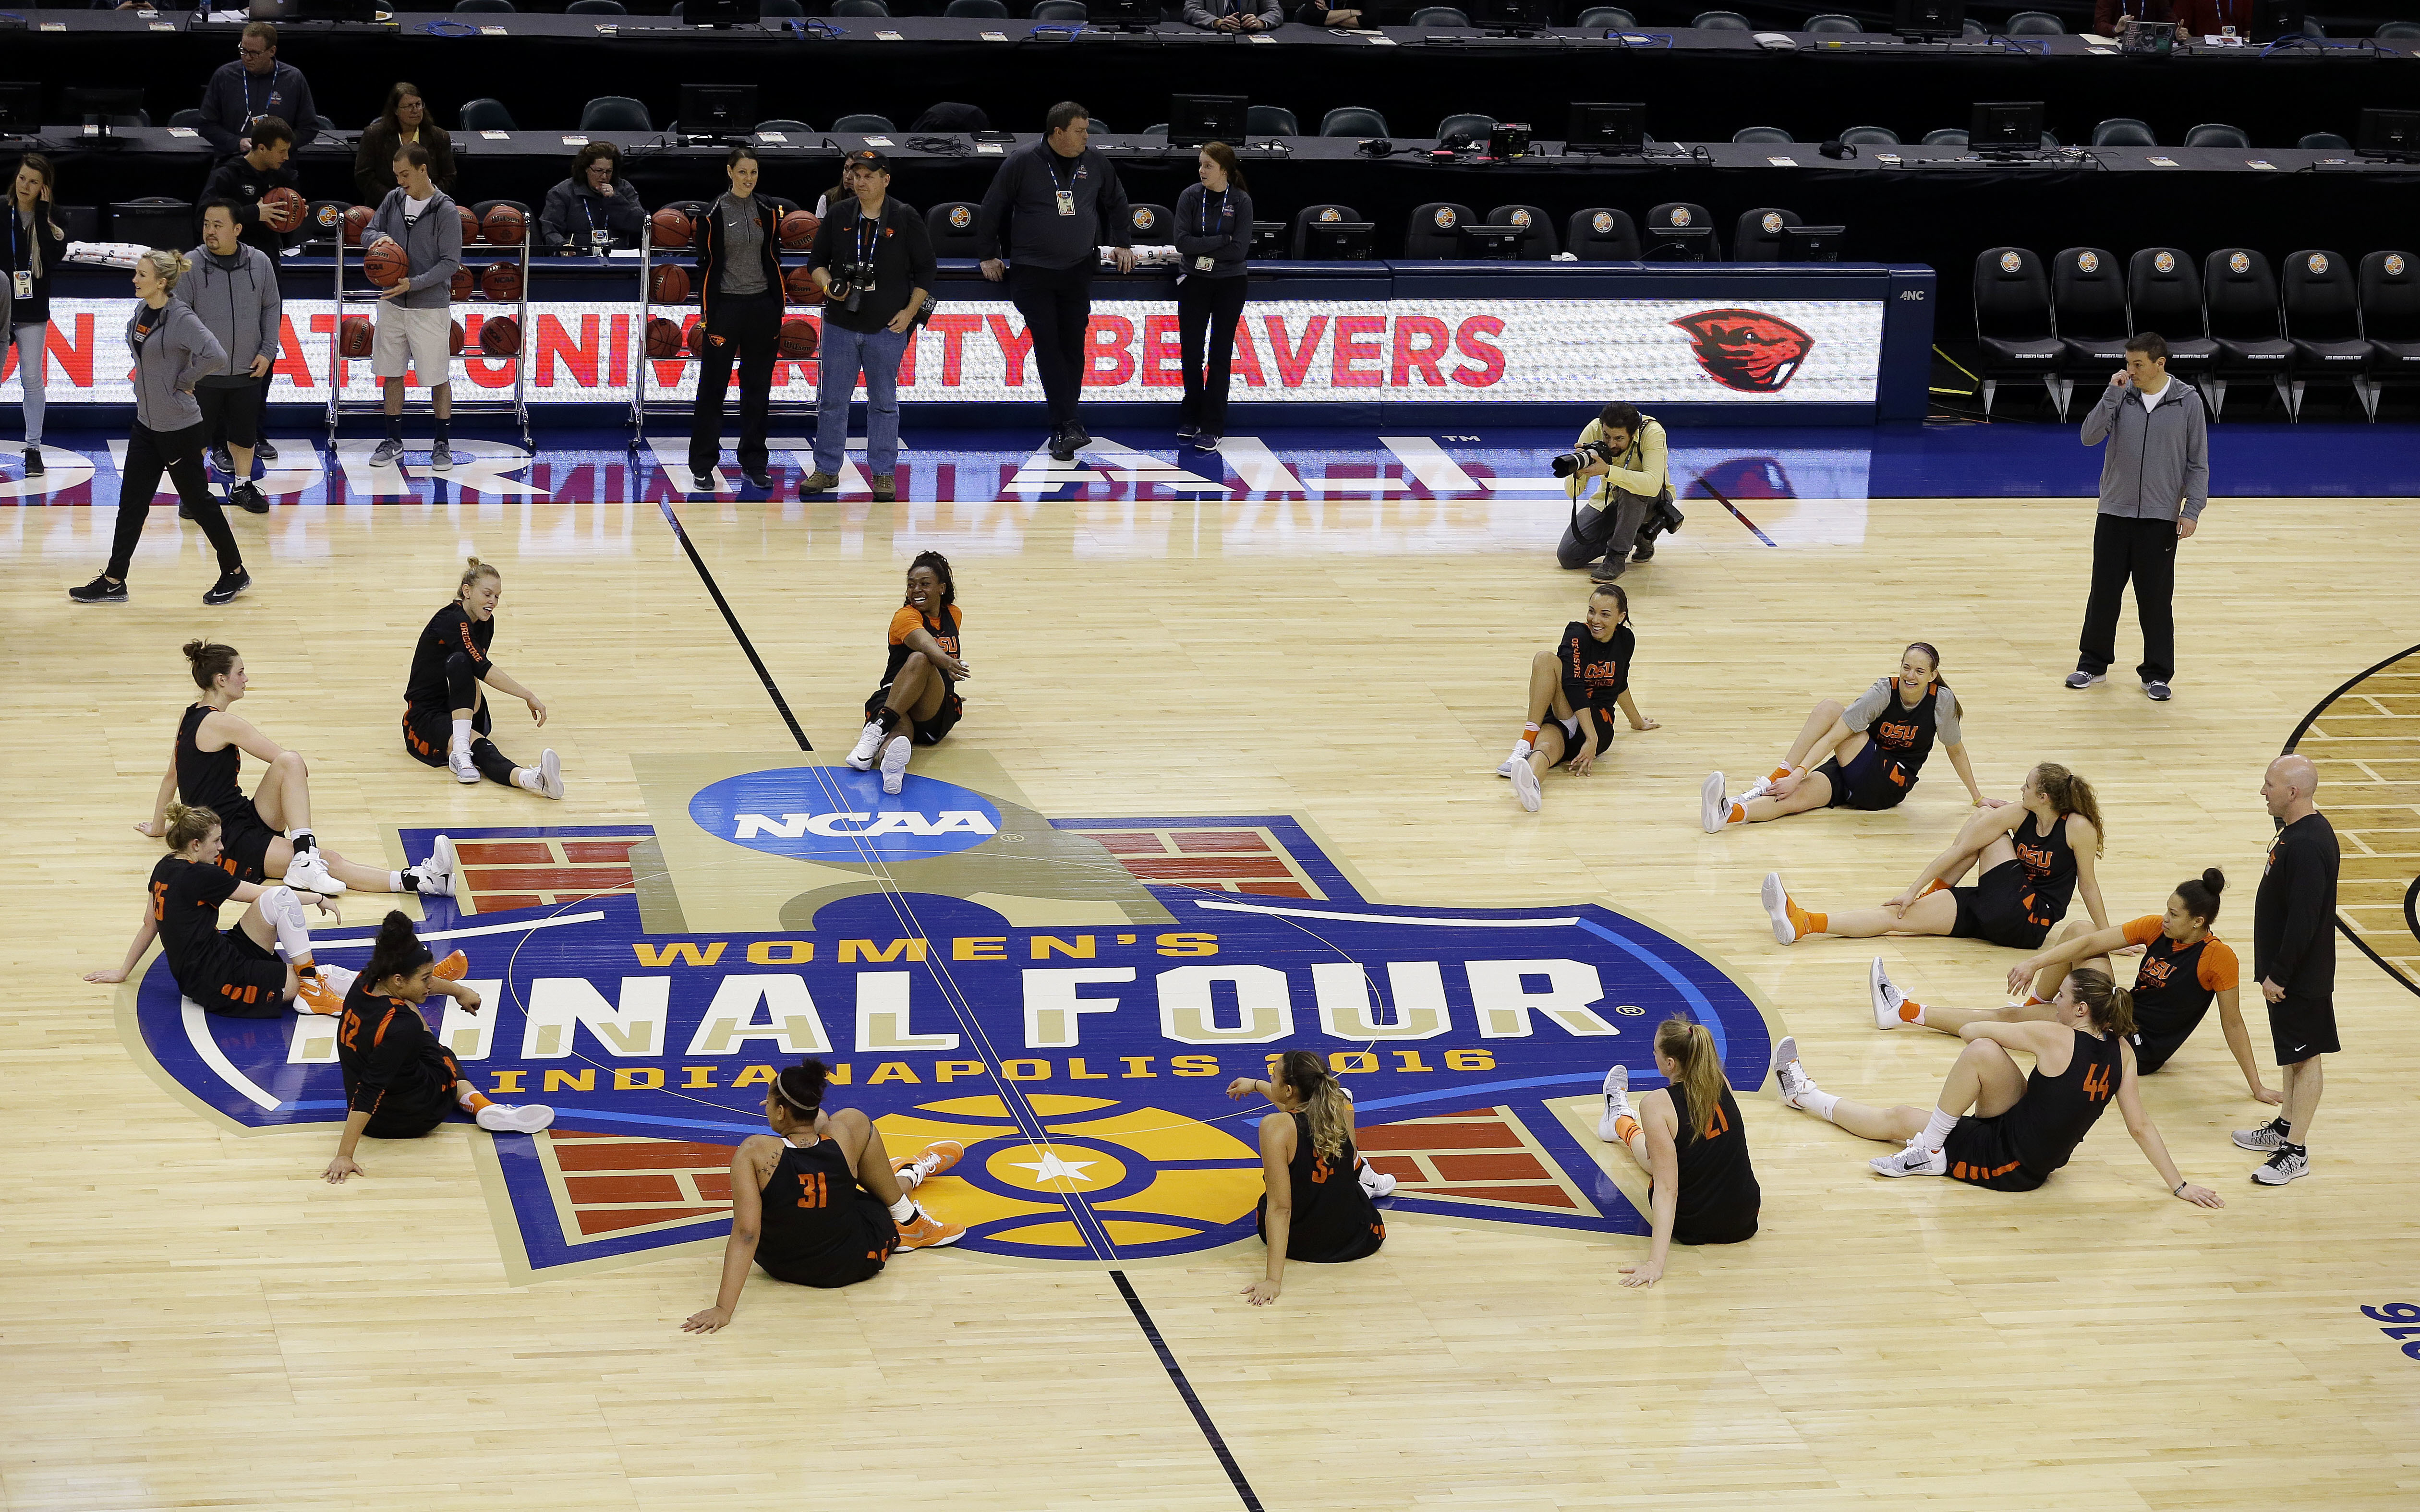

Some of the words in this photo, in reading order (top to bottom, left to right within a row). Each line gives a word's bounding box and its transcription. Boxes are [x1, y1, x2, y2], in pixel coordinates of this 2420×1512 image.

[290, 193, 299, 224] Wilson
[491, 215, 519, 223] Wilson
[786, 234, 813, 247] Wilson
[1900, 290, 1924, 300] ANC
[351, 323, 368, 350] Wilson
[784, 340, 811, 351] Wilson
[1585, 661, 1615, 679] OSU
[1880, 721, 1919, 740] OSU
[734, 810, 998, 839] NCAA
[2017, 843, 2053, 868] OSU
[633, 934, 1218, 966] WOMEN'S
[2142, 956, 2178, 980] OSU
[287, 971, 959, 1064] INAL
[1022, 959, 1621, 1048] FOUR
[340, 1008, 361, 1052] 12
[2083, 1063, 2111, 1101] 44
[797, 1172, 828, 1209] 31
